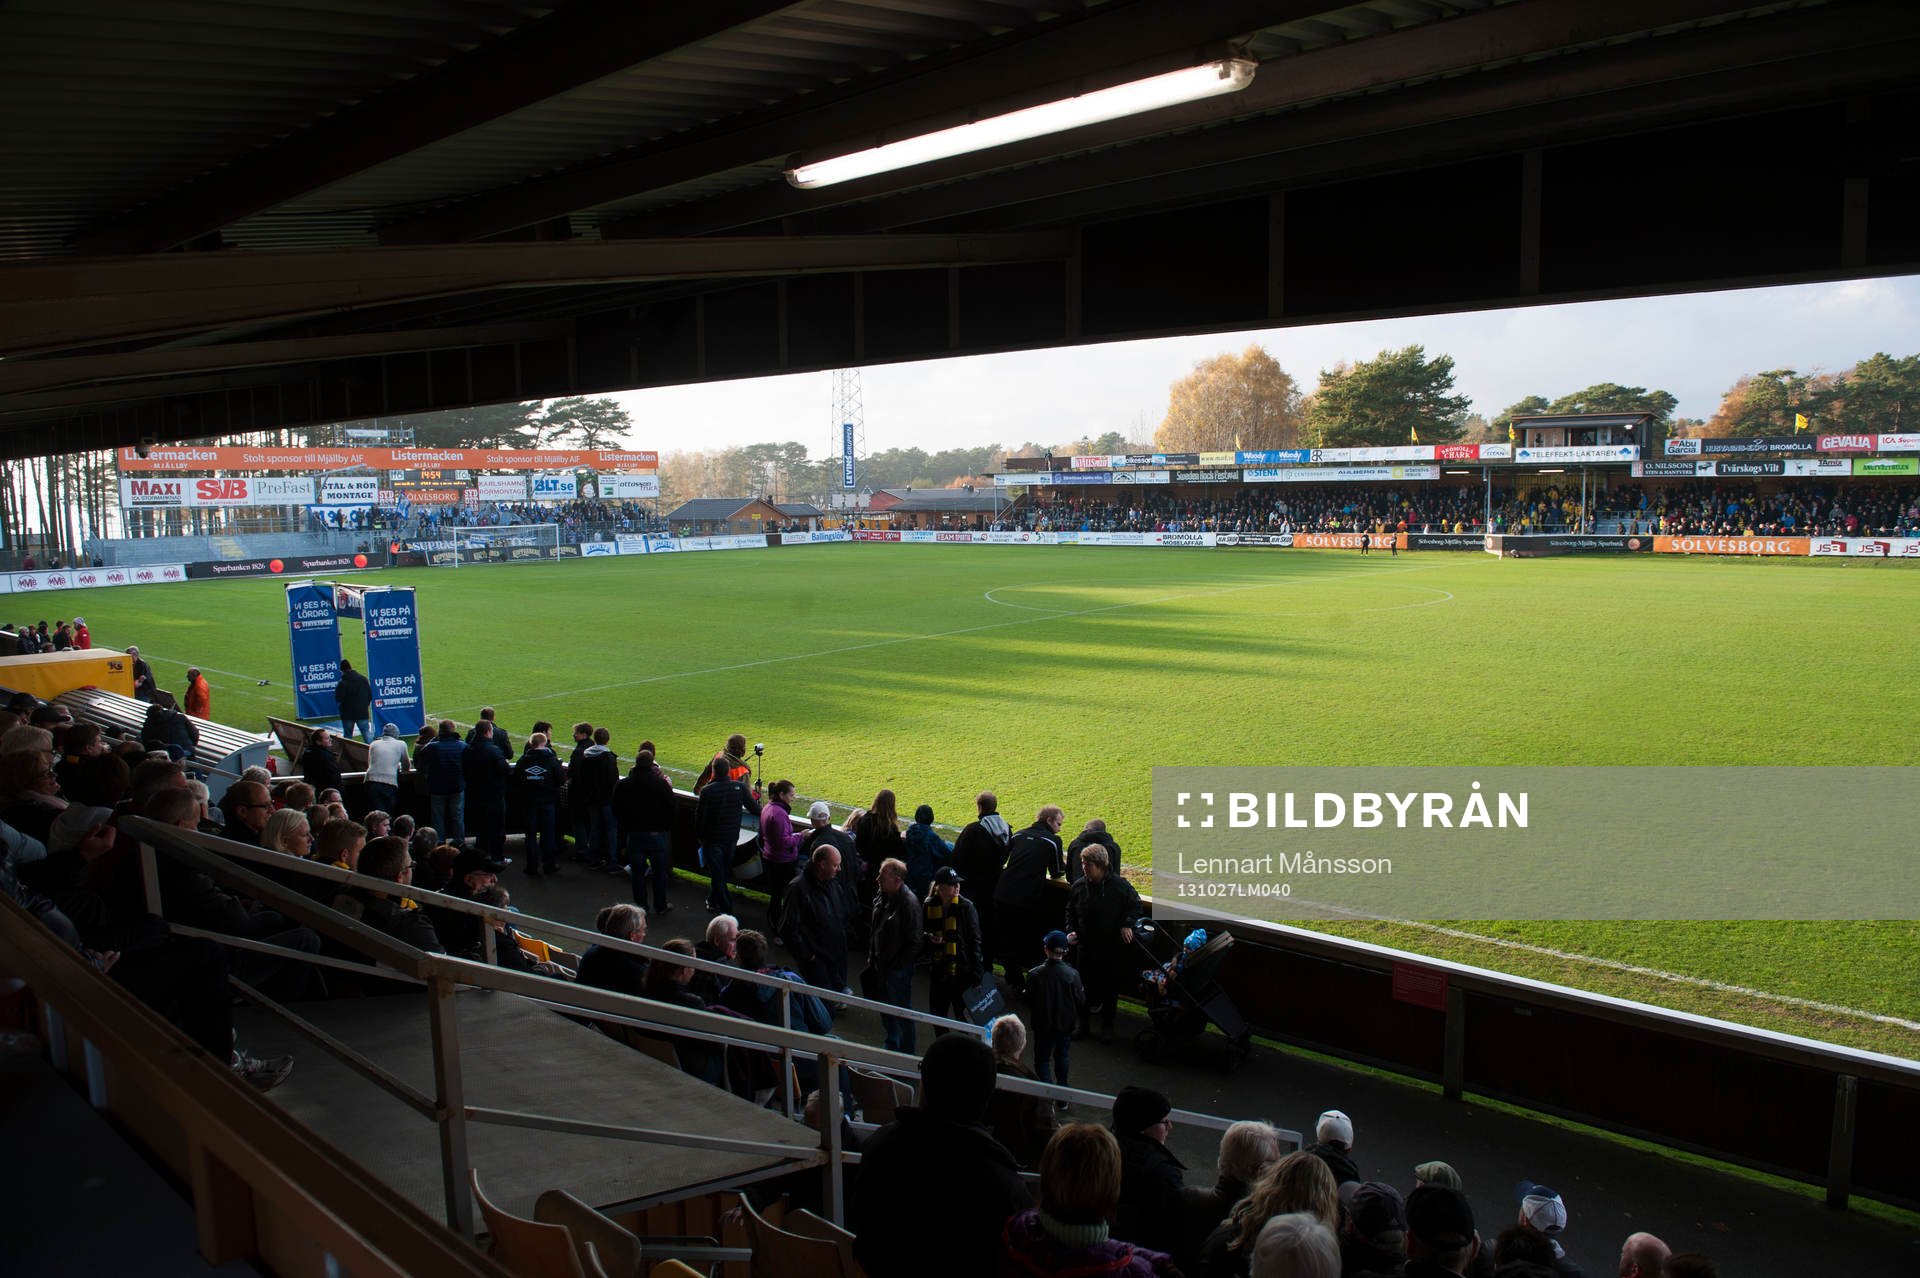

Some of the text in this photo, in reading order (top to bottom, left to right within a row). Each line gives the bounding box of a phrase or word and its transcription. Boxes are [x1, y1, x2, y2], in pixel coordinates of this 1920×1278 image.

[1679, 440, 1696, 448] Abu
[1769, 443, 1812, 451] BROMÖLLA
[1822, 436, 1871, 449] GEVALIA
[125, 449, 217, 460] Liermacken
[391, 450, 464, 461] Listermacken
[1668, 446, 1696, 454] Garcia
[243, 453, 364, 465] Stolt sponsor till Mjällby AIF
[486, 455, 580, 465] Stolt sponsor till Mjällby AIF
[599, 452, 656, 462] Listermacken
[1243, 452, 1265, 462] Woody
[1279, 451, 1301, 462] Woody
[1721, 463, 1779, 473] Tvärskogs Vilt
[1176, 471, 1199, 481] Sweden
[131, 481, 182, 496] MAXI
[196, 480, 247, 499] SVB
[257, 480, 311, 494] PreFast
[356, 481, 377, 489] RÖR
[534, 480, 574, 492] BLT.se
[406, 492, 457, 501] ÖLVESBORG
[464, 489, 478, 497] SYD
[811, 531, 845, 542] Ballingslöv
[1306, 534, 1393, 547] SÖLVESBORG
[1671, 536, 1790, 553] SÖLVESBORG
[1902, 543, 1920, 554] JS
[213, 563, 266, 573] Sparbanken 1826
[302, 558, 351, 568] Sparbanken 1826
[294, 602, 302, 610] VI
[303, 601, 319, 610] SES
[370, 605, 410, 617] VI SES PÅ
[297, 609, 329, 619] LÖRDAG
[374, 616, 408, 627] LÖRDAG
[299, 660, 337, 673] VI SES PÅ
[304, 671, 334, 682] LÖRDAG
[375, 675, 416, 687] VI SES PÅ
[308, 682, 337, 690] STRYKTIPSE
[379, 685, 413, 696] LÖRDAG
